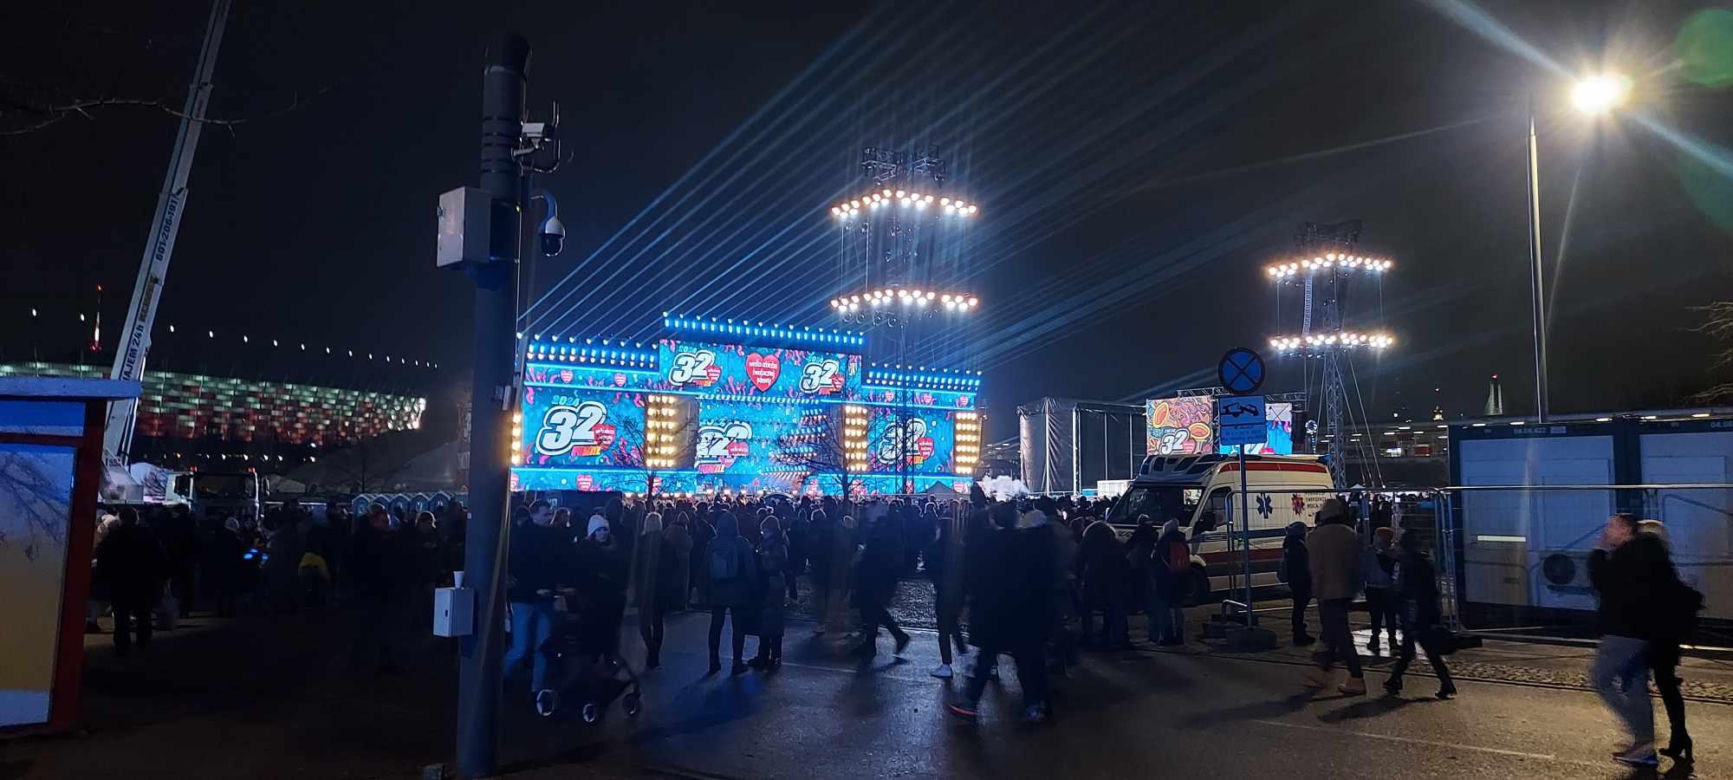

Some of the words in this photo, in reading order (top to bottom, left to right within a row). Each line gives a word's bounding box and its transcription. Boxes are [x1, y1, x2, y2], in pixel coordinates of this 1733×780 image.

[669, 350, 714, 386] 32
[800, 360, 839, 393] 32
[538, 402, 606, 455] 32
[1160, 429, 1189, 455] 32
